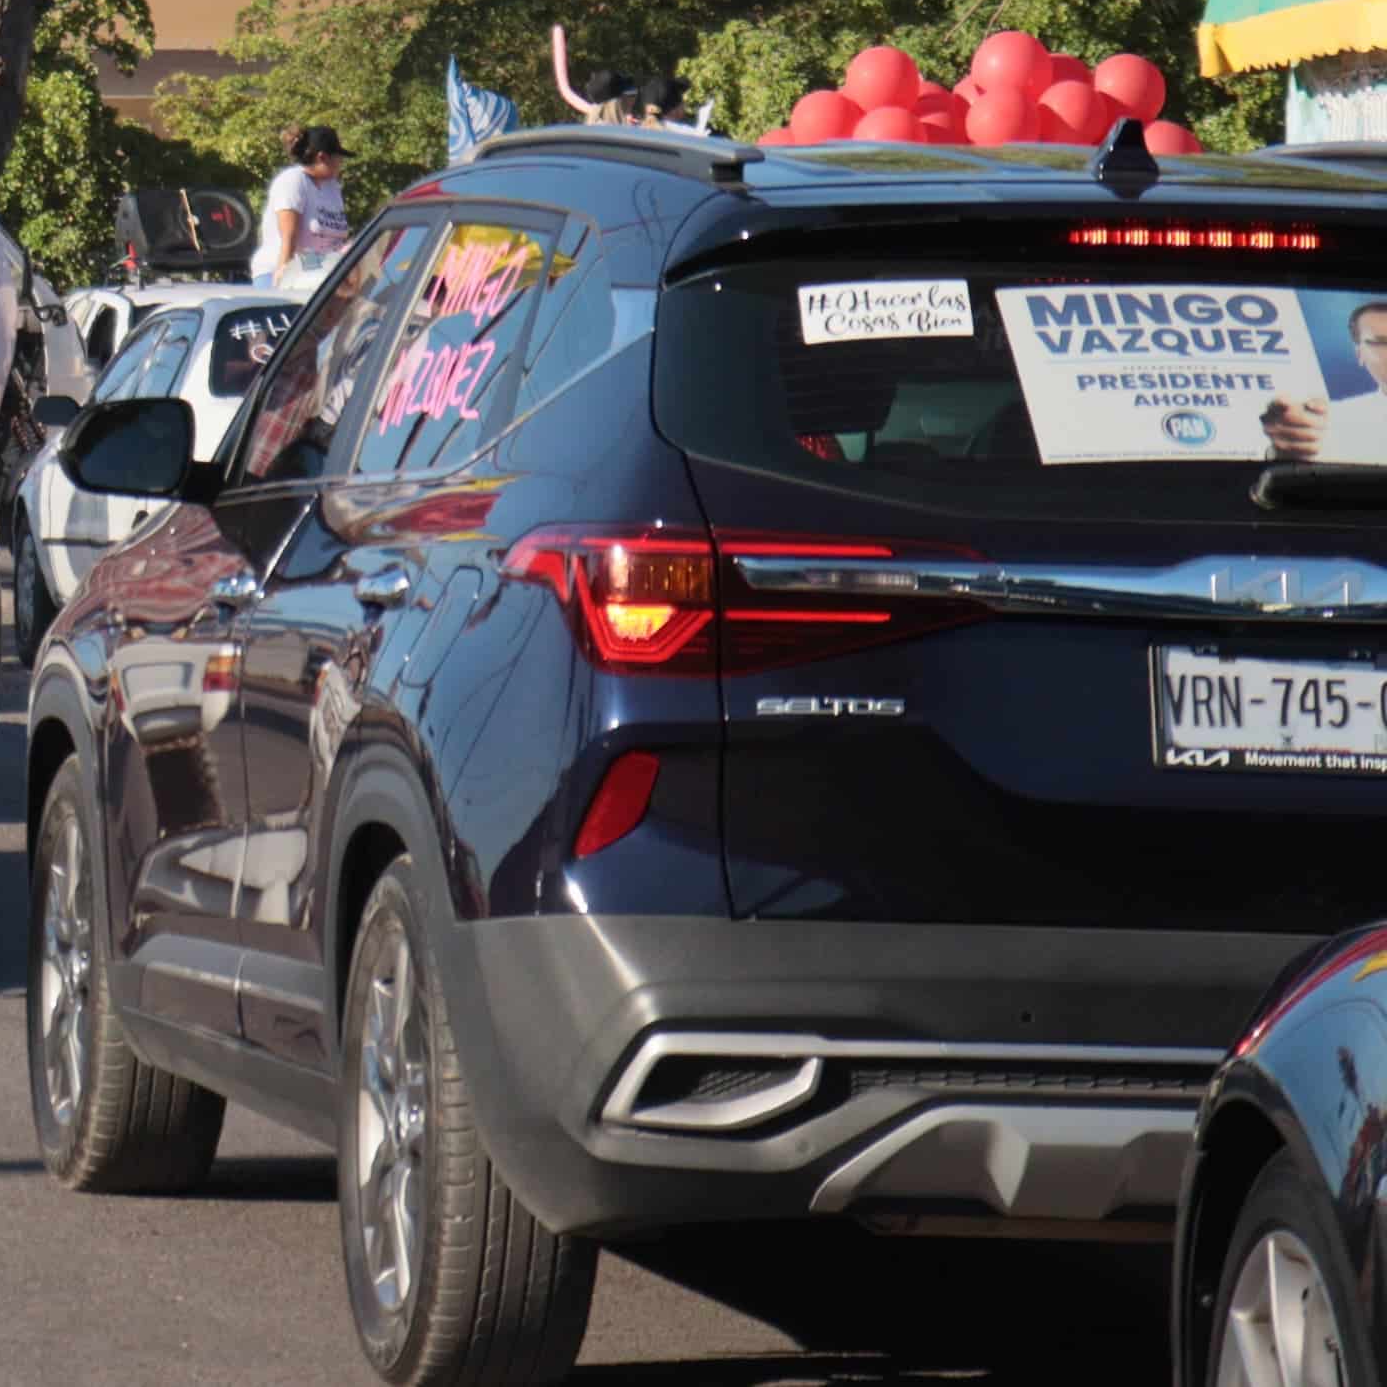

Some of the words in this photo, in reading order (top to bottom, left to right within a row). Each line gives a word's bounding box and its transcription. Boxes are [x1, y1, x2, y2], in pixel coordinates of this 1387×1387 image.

[1025, 292, 1279, 327] MINGO
[823, 311, 901, 336] Cosas
[1034, 327, 1291, 356] VAZQUEZ
[1075, 372, 1277, 391] PRESIDENTE
[1133, 392, 1230, 408] AHOME
[1171, 416, 1209, 440] PAN
[756, 697, 905, 716] SELTOS
[1165, 674, 1387, 730] VRN-745-
[1244, 750, 1322, 768] Movement
[1325, 753, 1358, 770] that
